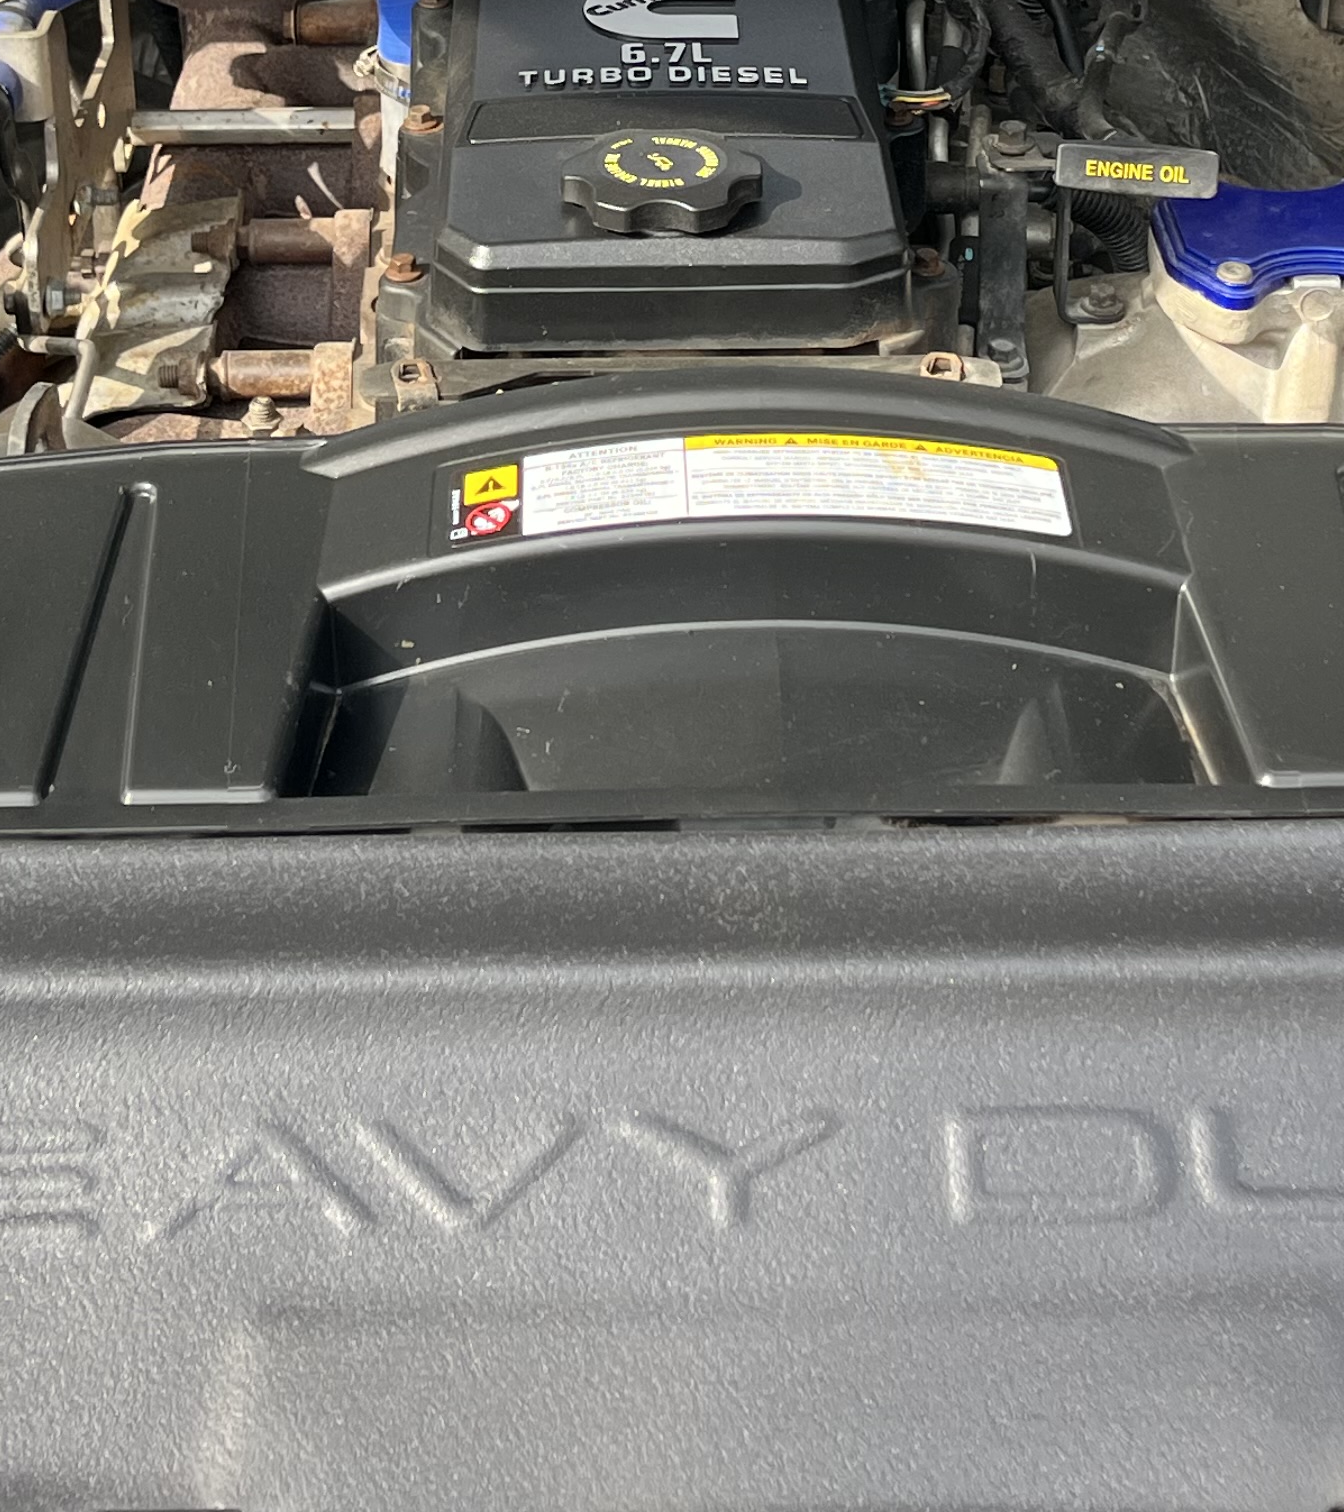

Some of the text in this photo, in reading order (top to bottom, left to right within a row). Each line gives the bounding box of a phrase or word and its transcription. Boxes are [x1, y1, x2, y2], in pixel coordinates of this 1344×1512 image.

[621, 42, 712, 64] 6.7L
[518, 65, 808, 86] TURBO DIESEL
[1085, 159, 1190, 184] ENGINE OIL
[568, 445, 638, 460] ATTENTION
[714, 437, 1024, 463] WARNING MISE EN GARDE ADVERTENCIA
